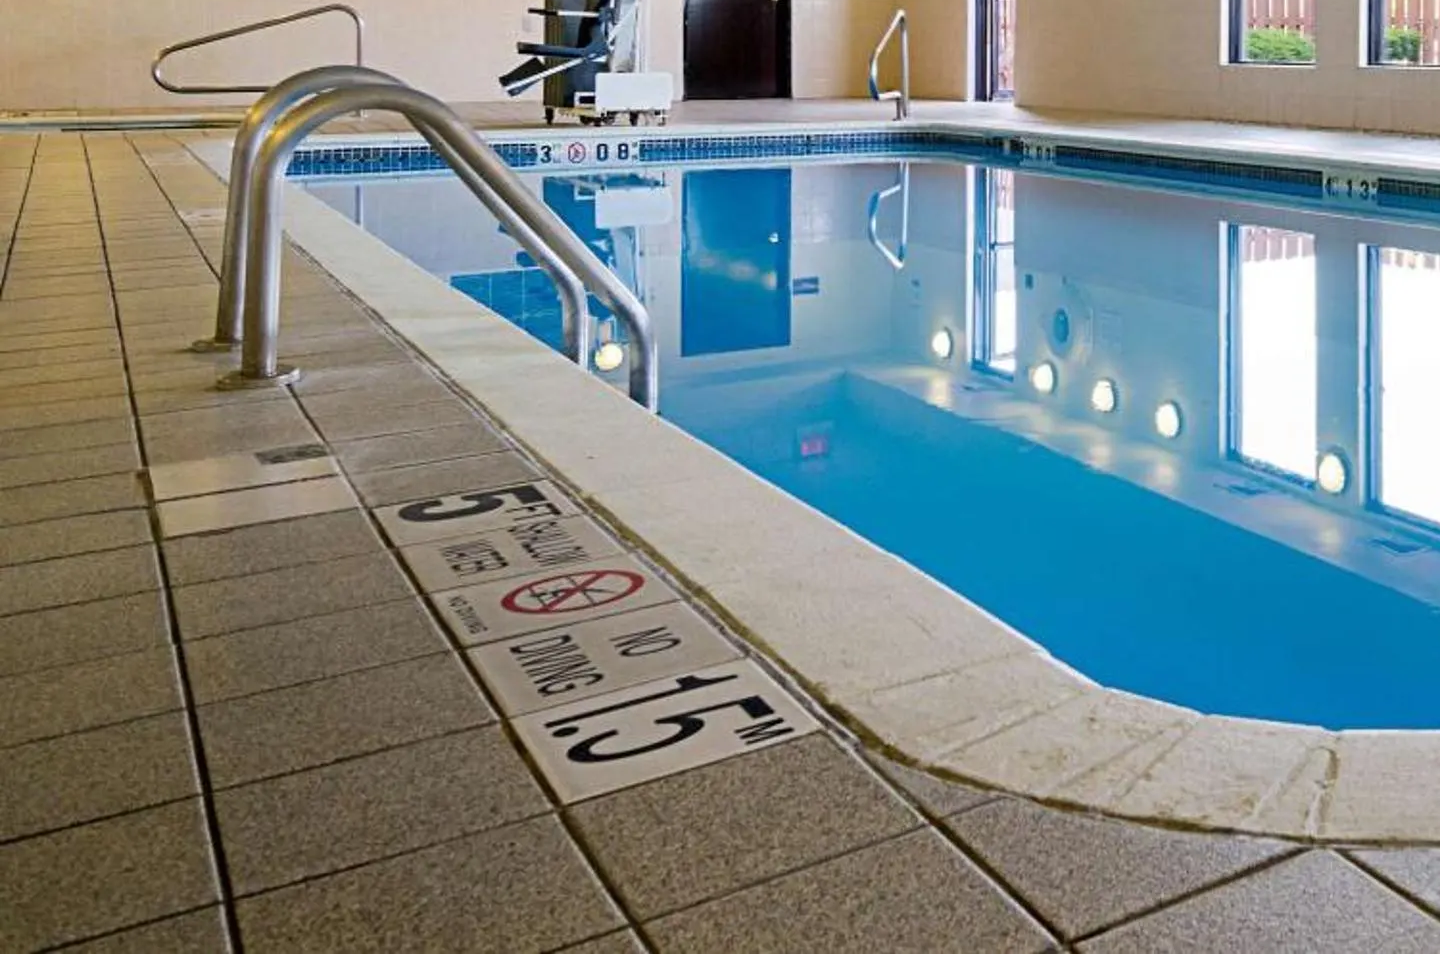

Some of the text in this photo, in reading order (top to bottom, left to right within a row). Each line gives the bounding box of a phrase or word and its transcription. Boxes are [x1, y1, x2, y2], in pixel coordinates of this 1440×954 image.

[540, 145, 552, 163] 3
[438, 539, 509, 578] WATER
[609, 625, 681, 657] NO
[509, 634, 604, 696] DIVING
